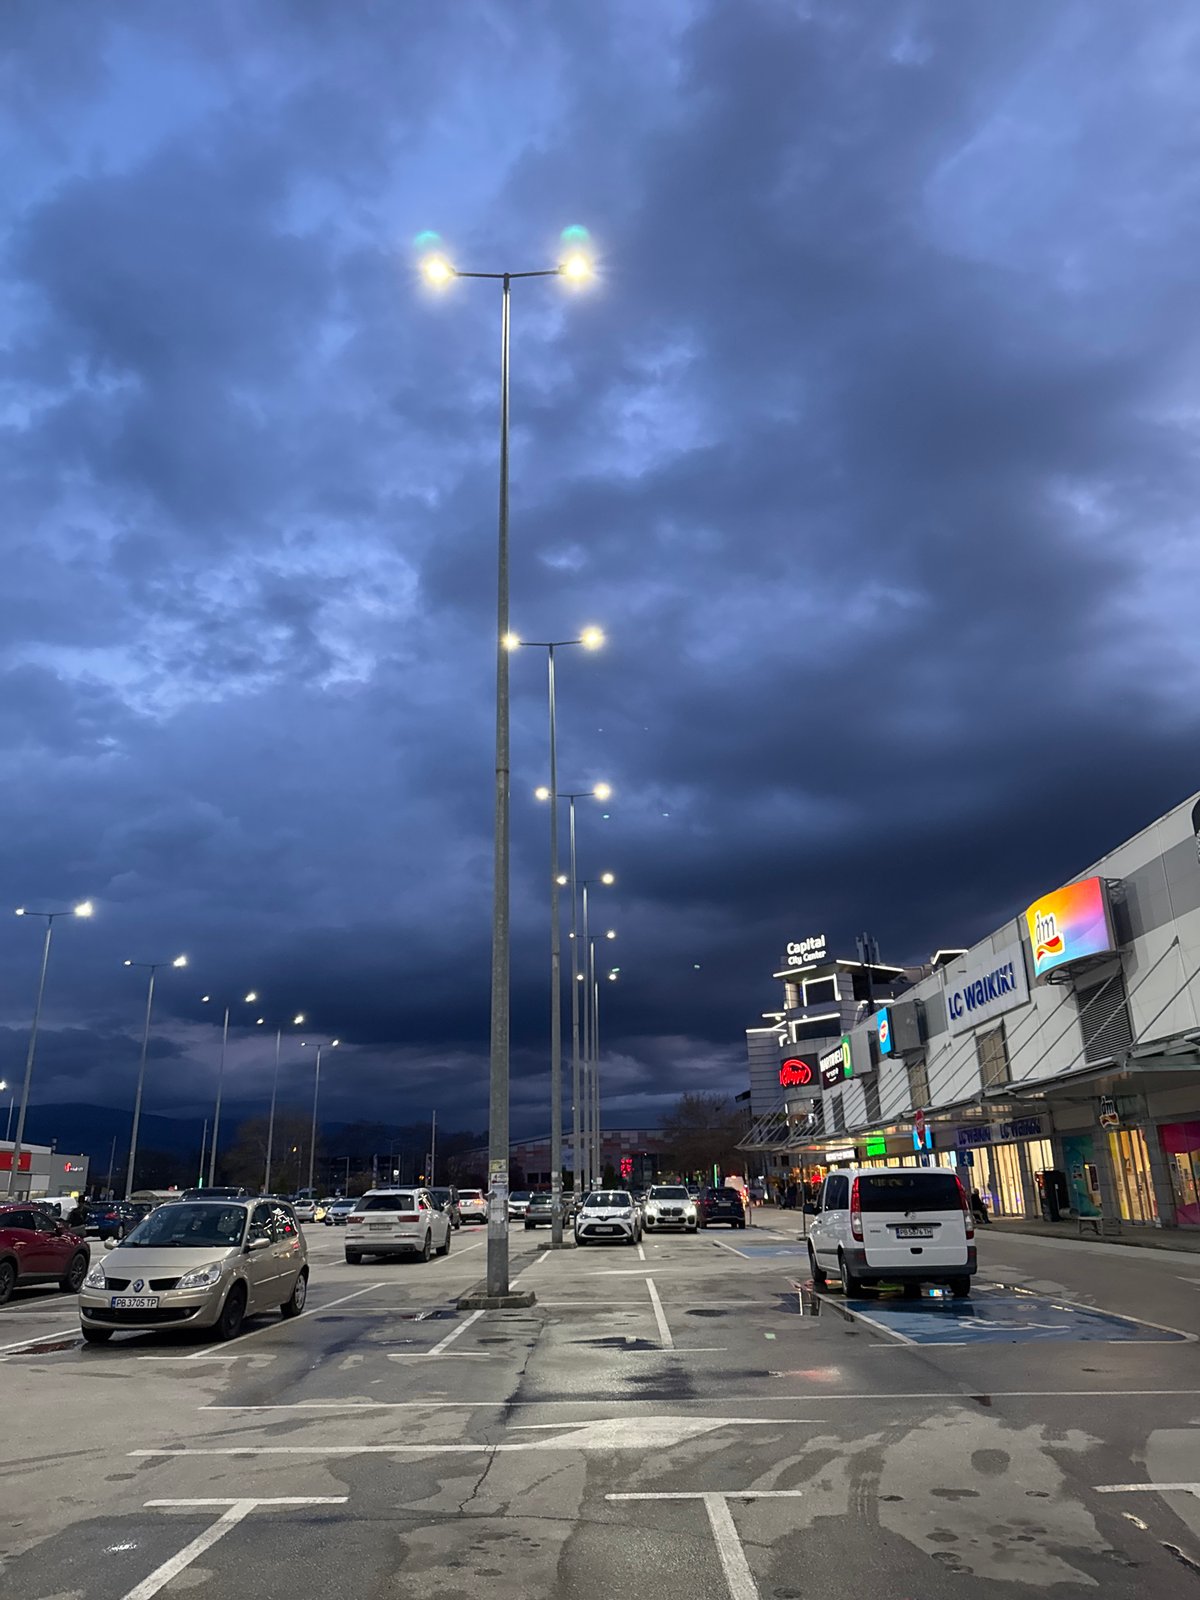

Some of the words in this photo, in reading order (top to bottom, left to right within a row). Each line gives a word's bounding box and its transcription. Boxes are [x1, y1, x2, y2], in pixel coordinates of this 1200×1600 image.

[787, 934, 826, 955] Capital
[788, 955, 803, 966] City
[803, 950, 827, 962] Center
[948, 992, 963, 1020] LC
